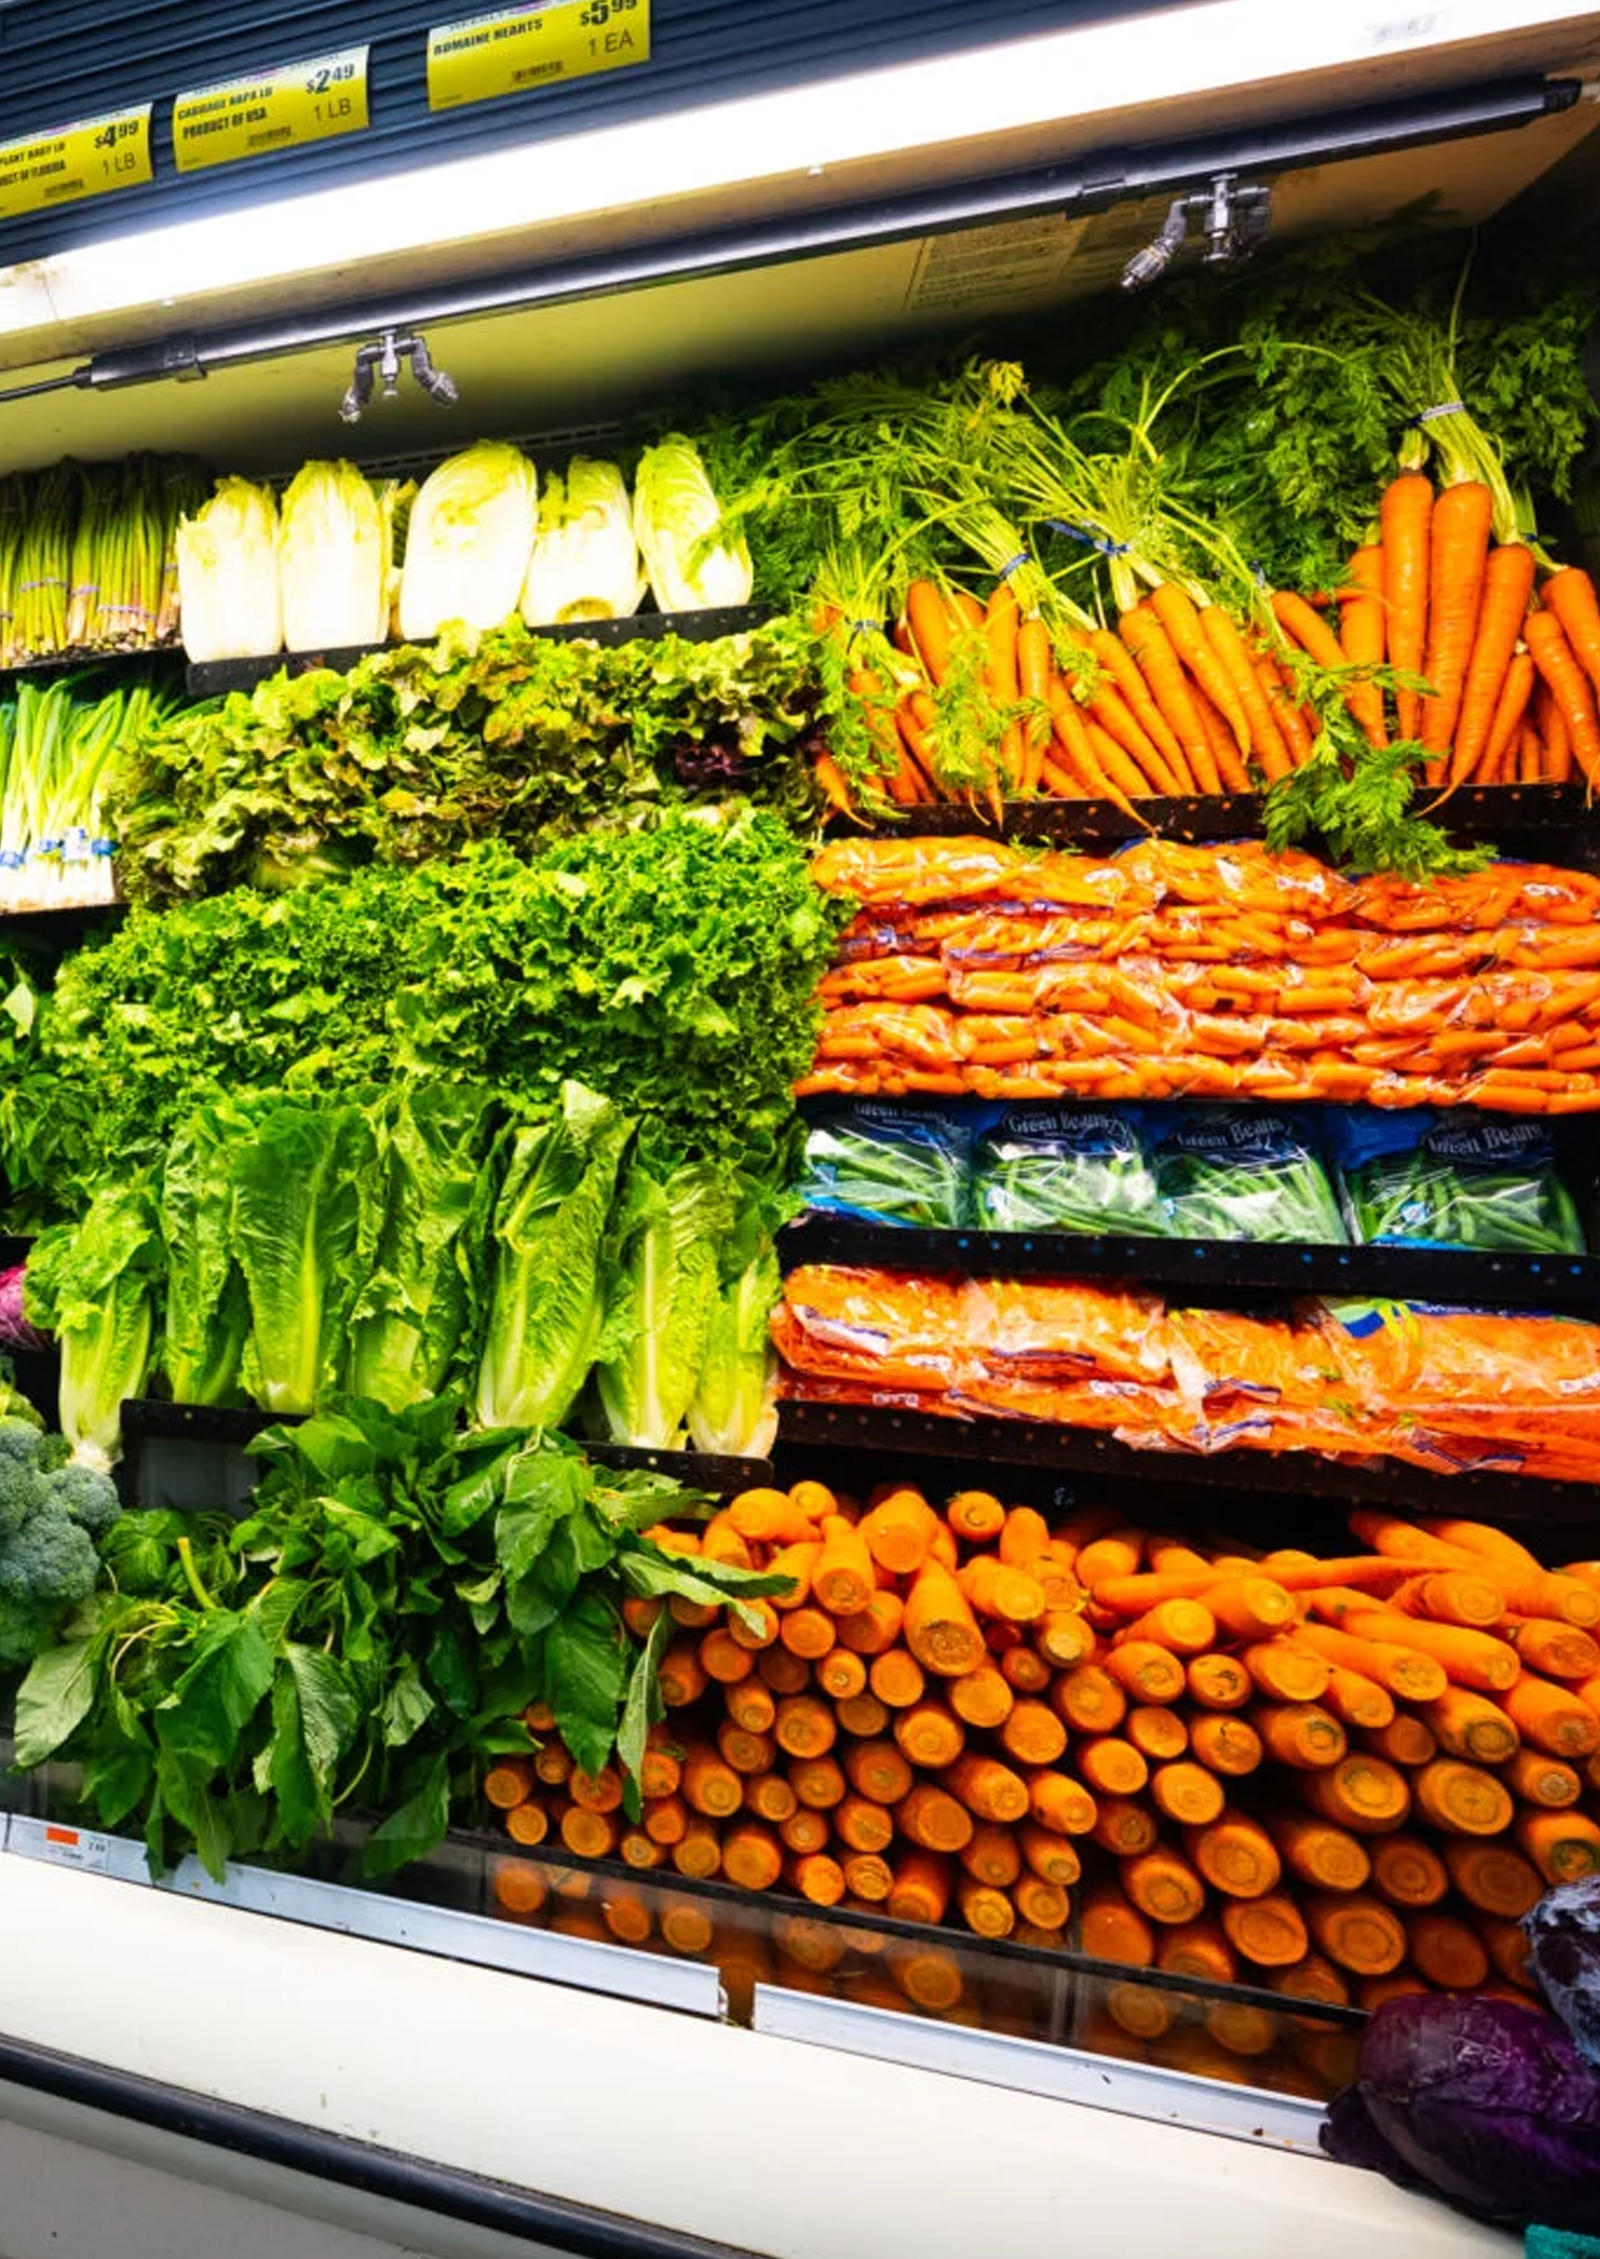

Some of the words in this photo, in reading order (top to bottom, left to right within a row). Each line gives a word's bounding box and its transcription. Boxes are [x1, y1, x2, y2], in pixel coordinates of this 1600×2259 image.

[493, 19, 543, 40] HEARTS
[590, 38, 596, 57] 1
[605, 28, 634, 53] EA
[314, 104, 321, 121] 1
[328, 98, 351, 118] LB
[183, 116, 229, 140] PRODUCT
[231, 112, 244, 127] OF
[246, 107, 267, 123] USA
[103, 159, 109, 175] 1
[114, 152, 136, 172] LB
